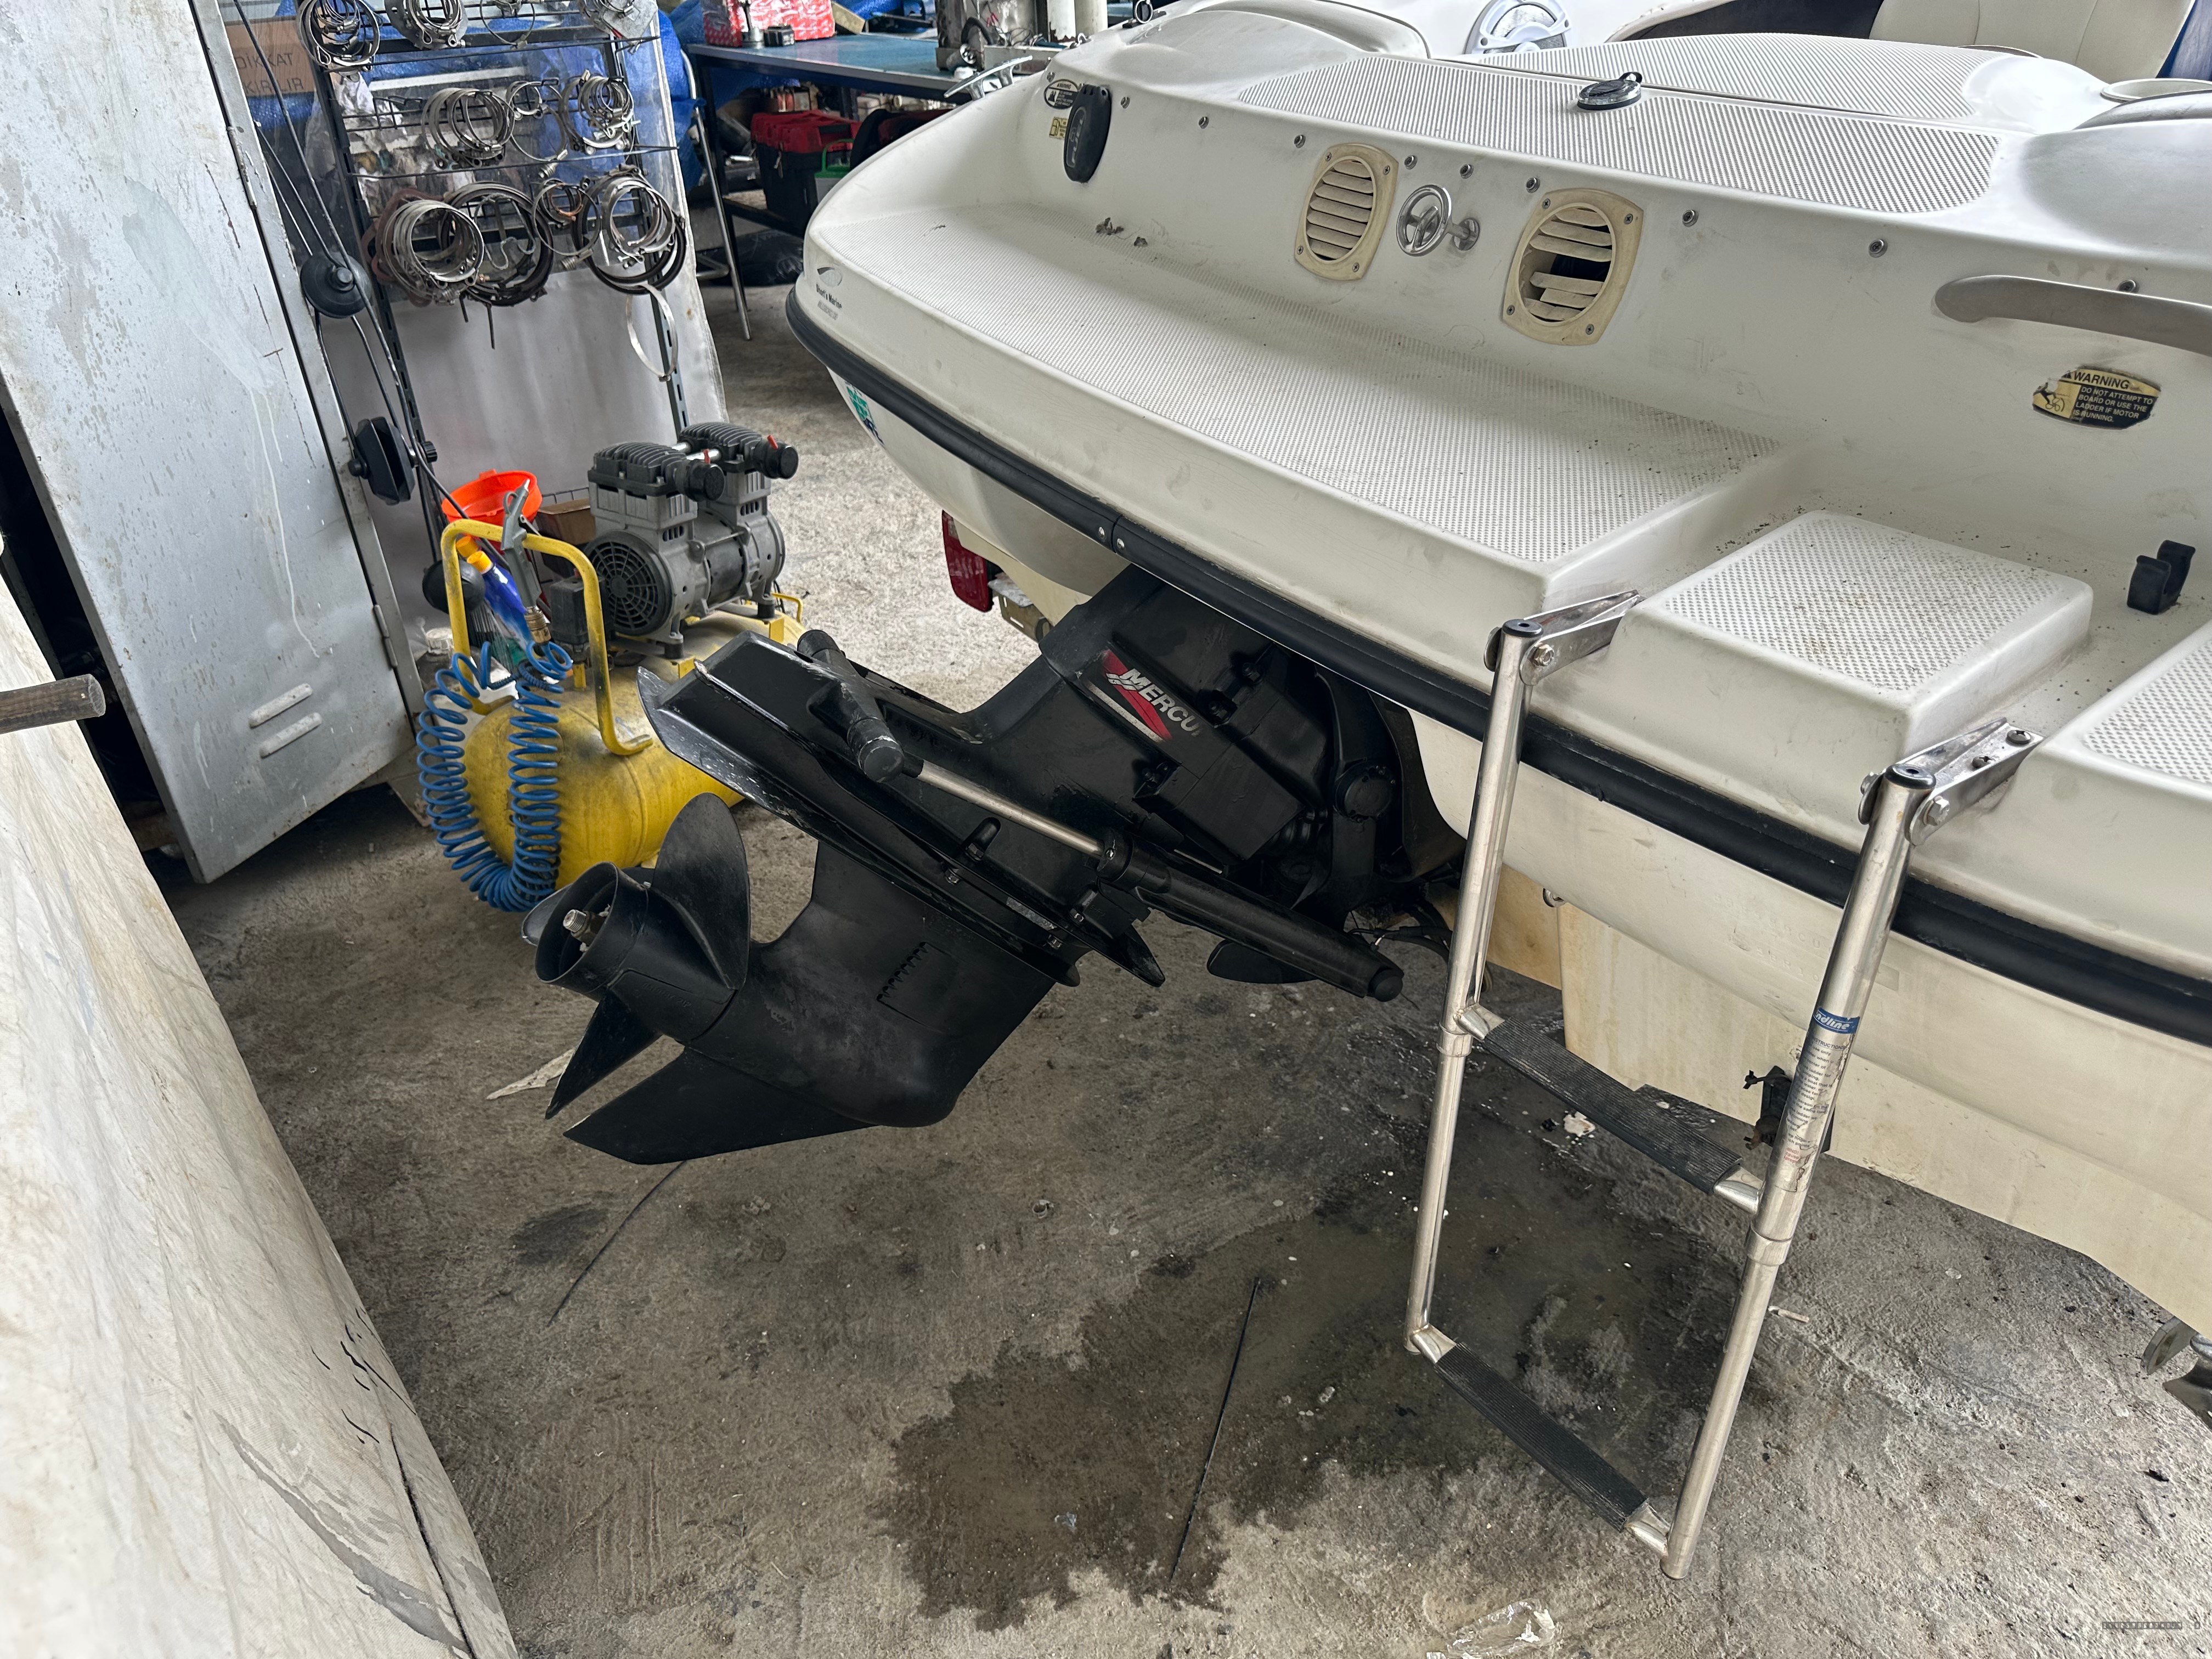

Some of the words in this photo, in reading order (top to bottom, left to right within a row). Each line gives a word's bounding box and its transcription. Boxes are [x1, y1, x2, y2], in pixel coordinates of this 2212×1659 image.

[242, 77, 304, 94] KIRLIR
[2073, 371, 2130, 390] WARNING
[2078, 394, 2103, 404] BOARD
[2104, 399, 2116, 407] OR
[2117, 401, 2132, 410] USE
[2132, 404, 2147, 413] THE
[2093, 389, 2108, 398] NOT
[2109, 392, 2142, 404] ATTEMPT
[2142, 397, 2153, 405] TO
[2075, 402, 2104, 413] LADDER
[2112, 409, 2139, 419] MOTOR
[2081, 411, 2114, 422] RUNNING.
[1119, 668, 1203, 737] MERCU
[1796, 1110, 1810, 1118] ladder
